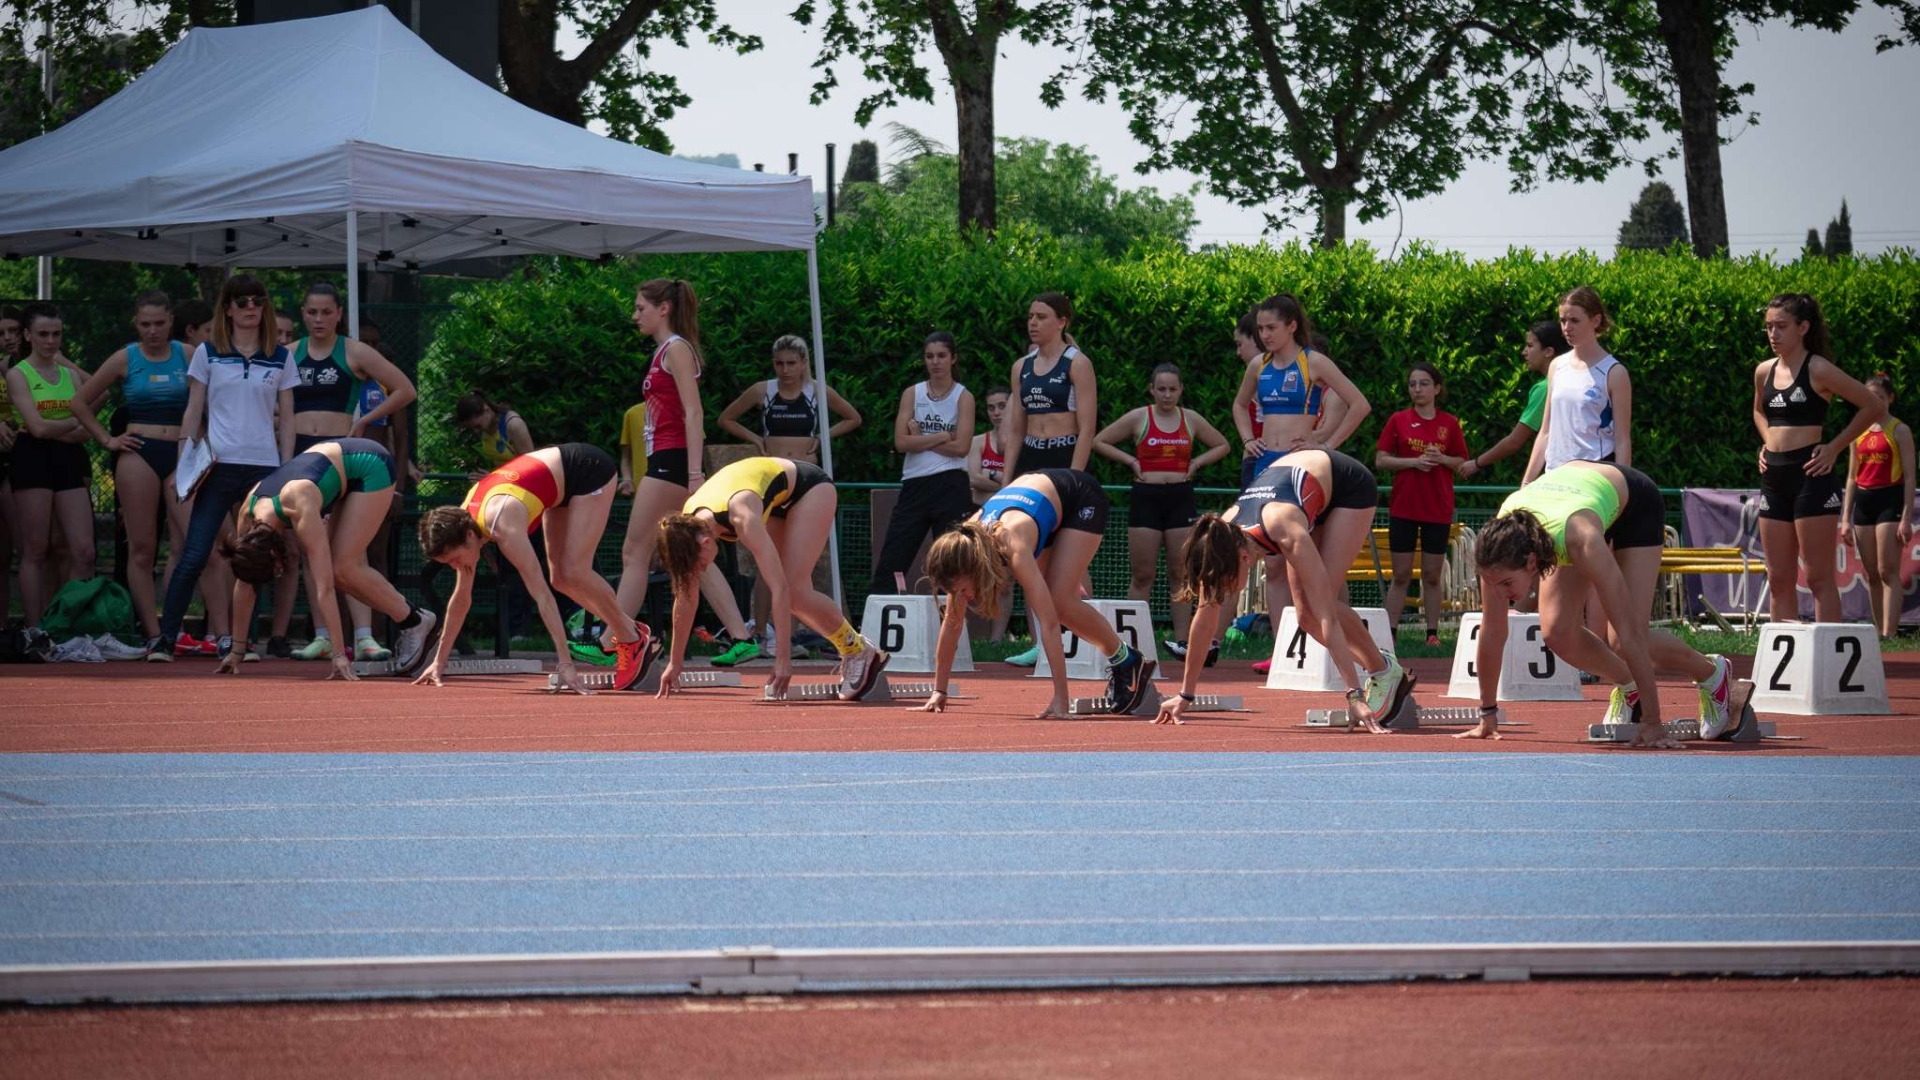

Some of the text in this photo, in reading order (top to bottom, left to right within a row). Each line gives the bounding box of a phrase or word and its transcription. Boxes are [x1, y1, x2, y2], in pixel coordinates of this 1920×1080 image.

[1025, 434, 1077, 450] NIKE PRO
[879, 604, 907, 653] 6
[1115, 608, 1138, 651] 5
[1286, 625, 1307, 669] 4
[1526, 624, 1556, 679] 3
[1769, 634, 1865, 693] 2 2
